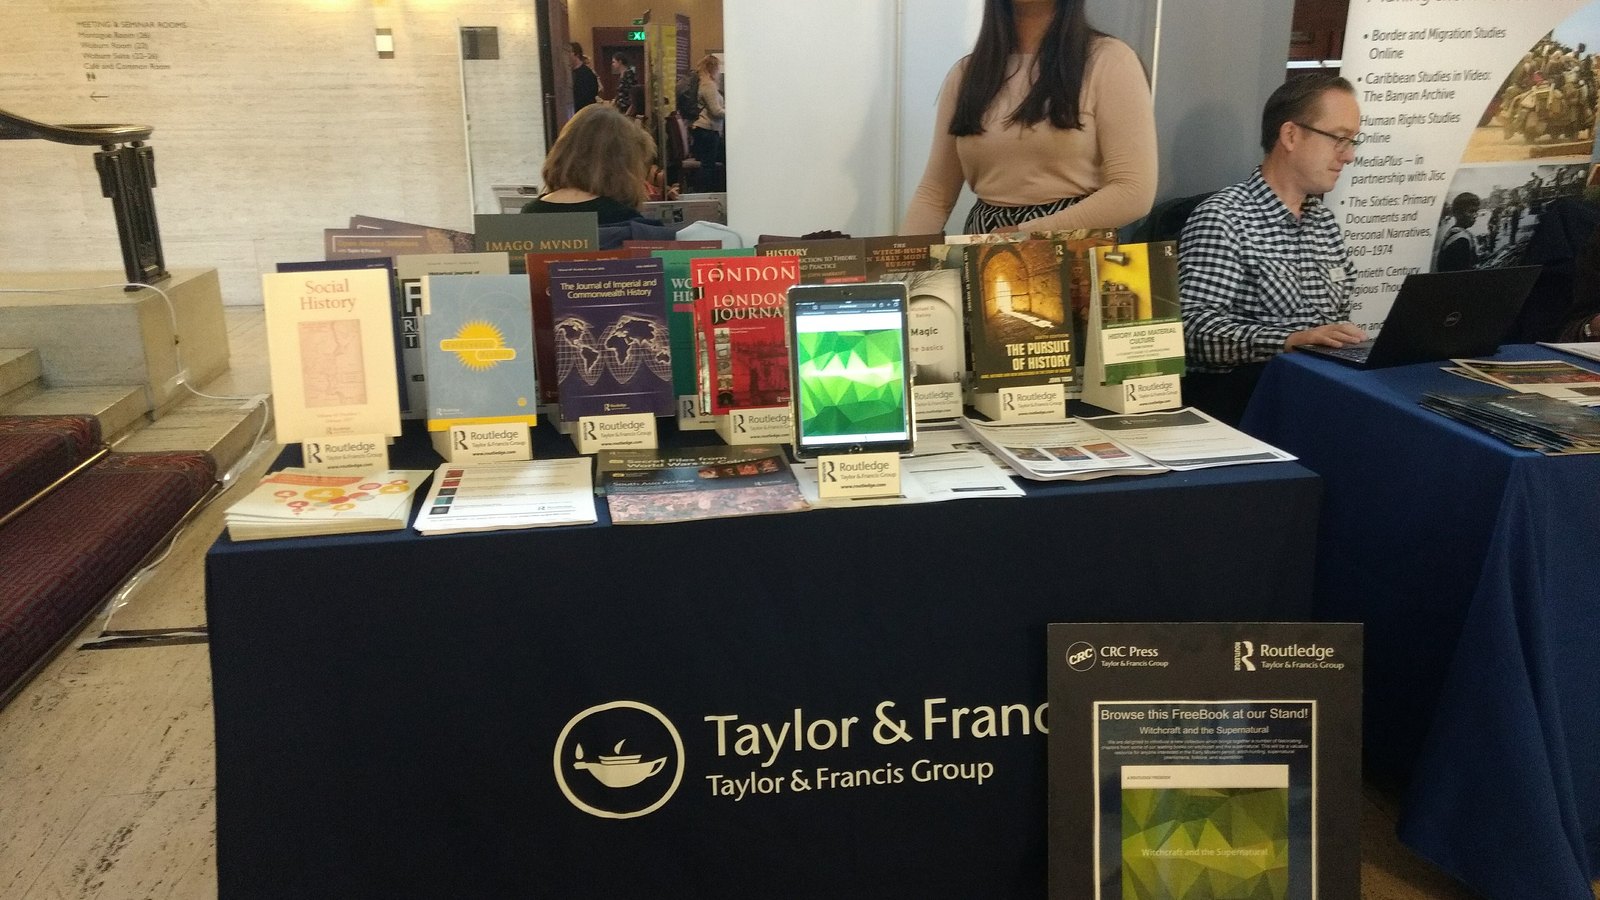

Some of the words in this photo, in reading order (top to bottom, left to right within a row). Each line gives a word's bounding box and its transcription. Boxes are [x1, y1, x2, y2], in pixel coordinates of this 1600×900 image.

[1371, 29, 1407, 41] Border
[1407, 28, 1426, 40] and
[1427, 27, 1472, 42] Migration
[1473, 26, 1507, 39] Studies
[1368, 47, 1404, 60] Online
[1365, 71, 1416, 84] Caribbean
[1417, 70, 1451, 83] Studies
[1452, 70, 1462, 82] in
[1463, 69, 1492, 81] Video:
[1364, 90, 1383, 102] The
[1385, 89, 1420, 104] Banyan
[1421, 88, 1456, 100] Archive
[1359, 114, 1396, 126] Human
[1397, 113, 1426, 127] Rights
[1427, 112, 1461, 124] Studies
[1357, 132, 1391, 144] Online
[1353, 155, 1403, 167] MediaPlus
[1414, 154, 1424, 165] in
[1351, 172, 1406, 187] partnership
[1407, 170, 1427, 182] with
[1428, 170, 1447, 181] Jisc
[1348, 196, 1367, 207] The
[1369, 195, 1401, 207] Sixties:
[1401, 194, 1437, 206] Primary
[1345, 212, 1399, 224] Documents
[1401, 211, 1418, 221] and
[1343, 228, 1385, 240] Personal
[1386, 226, 1432, 239] Narratives,
[486, 240, 534, 251] IMAGO
[540, 239, 589, 250] MVNDI
[1347, 244, 1393, 257] 960–1974
[766, 247, 808, 257] HISTORY
[903, 253, 928, 261] MODE
[696, 265, 796, 285] LONDON
[1357, 267, 1384, 279] ntieth
[1385, 265, 1421, 277] Century
[305, 278, 350, 294] Social
[560, 282, 575, 290] The
[576, 281, 602, 290] Journal
[603, 280, 612, 289] of
[613, 280, 641, 290] Imperial
[642, 279, 657, 287] and
[1380, 282, 1402, 293] Thou
[567, 289, 626, 299] Commonwealth
[627, 288, 652, 298] History
[300, 296, 356, 312] History
[714, 306, 785, 324] JOURNA
[911, 327, 939, 337] Magic
[1148, 328, 1177, 336] MATERIAL
[1129, 337, 1155, 345] CULTURE
[1005, 343, 1025, 356] THE
[1027, 340, 1070, 355] PURSUIT
[1012, 358, 1025, 371] OF
[1028, 354, 1071, 370] HISTORY
[1138, 381, 1173, 392] Routledge
[914, 389, 954, 401] Routledge
[1017, 391, 1057, 402] Routledge
[600, 420, 645, 431] Routledge
[471, 429, 519, 440] Routledge
[325, 442, 376, 453] Routledge
[840, 461, 889, 472] Routledge
[1069, 648, 1093, 665] CRC
[1100, 646, 1126, 657] CRC
[1129, 646, 1159, 657] Press
[1260, 643, 1335, 661] Routledge
[1101, 660, 1120, 668] Taylor
[1148, 660, 1169, 668] Group
[1261, 661, 1283, 670] Taylor
[1284, 661, 1291, 669] &
[1292, 661, 1318, 669] Francis
[1319, 661, 1345, 670] Group
[1101, 709, 1145, 720] Browse
[1147, 708, 1168, 720] this
[1171, 708, 1229, 720] FreeBook
[1232, 709, 1244, 719] at
[1247, 710, 1266, 719] our
[1269, 708, 1309, 719] Stand!
[704, 708, 859, 768] Taylor
[872, 700, 914, 745] &
[924, 697, 1048, 741] Franc
[1139, 726, 1181, 735] Witchcraft
[1182, 726, 1199, 735] and
[1200, 726, 1214, 735] the
[1216, 725, 1270, 736] Supernatural
[706, 771, 785, 801] Taylor
[790, 769, 812, 793] &
[816, 761, 905, 790] Francis
[911, 758, 994, 784] Group
[1141, 848, 1183, 857] Witchcraft
[1184, 848, 1199, 857] and
[1201, 848, 1215, 857] the
[1216, 848, 1268, 858] Supernatural
